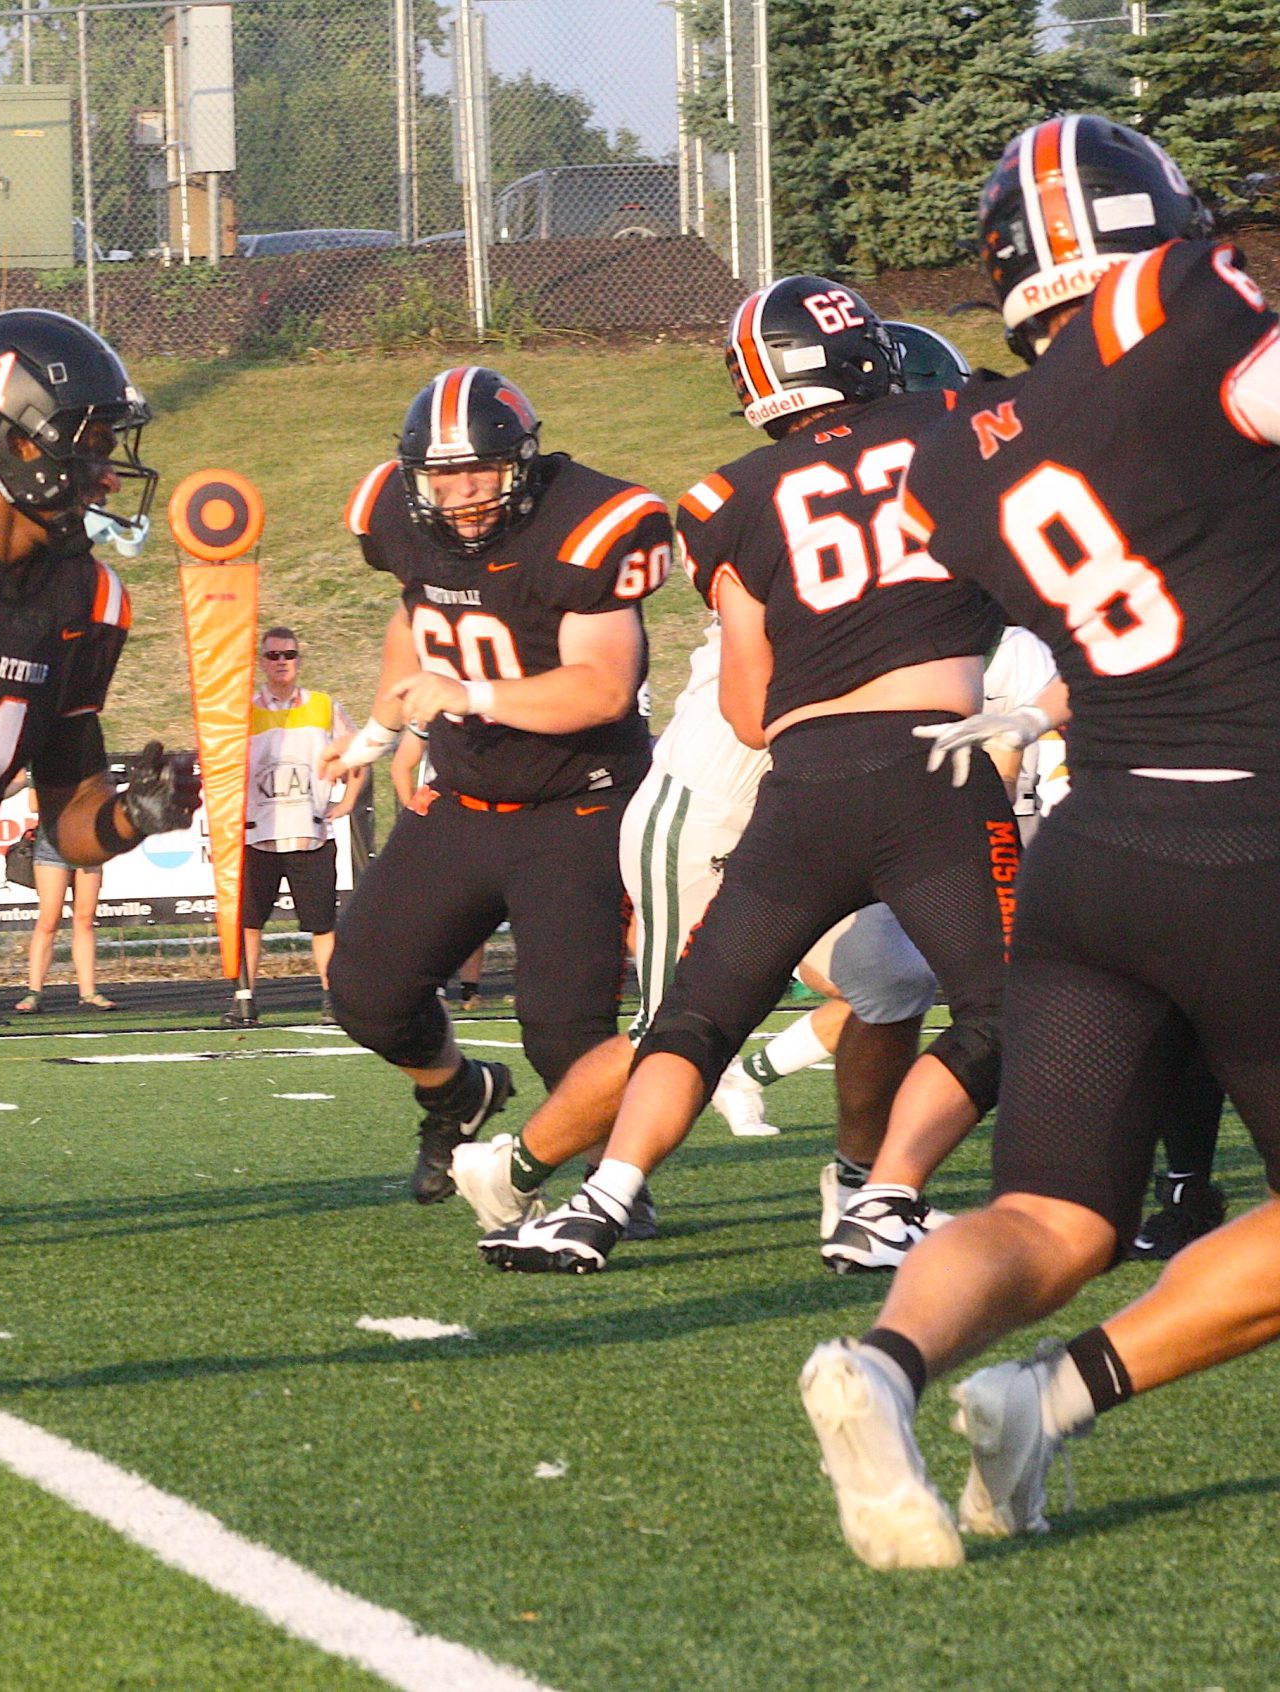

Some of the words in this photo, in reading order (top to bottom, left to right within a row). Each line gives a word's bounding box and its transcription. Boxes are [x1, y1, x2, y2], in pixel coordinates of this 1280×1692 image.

[803, 289, 865, 335] 62
[1022, 267, 1106, 305] Ridde
[747, 392, 806, 424] Riddell
[971, 400, 1023, 460] N
[772, 437, 956, 615] 62
[612, 542, 673, 600] 60
[999, 459, 1184, 677] 8
[410, 602, 526, 726] 60
